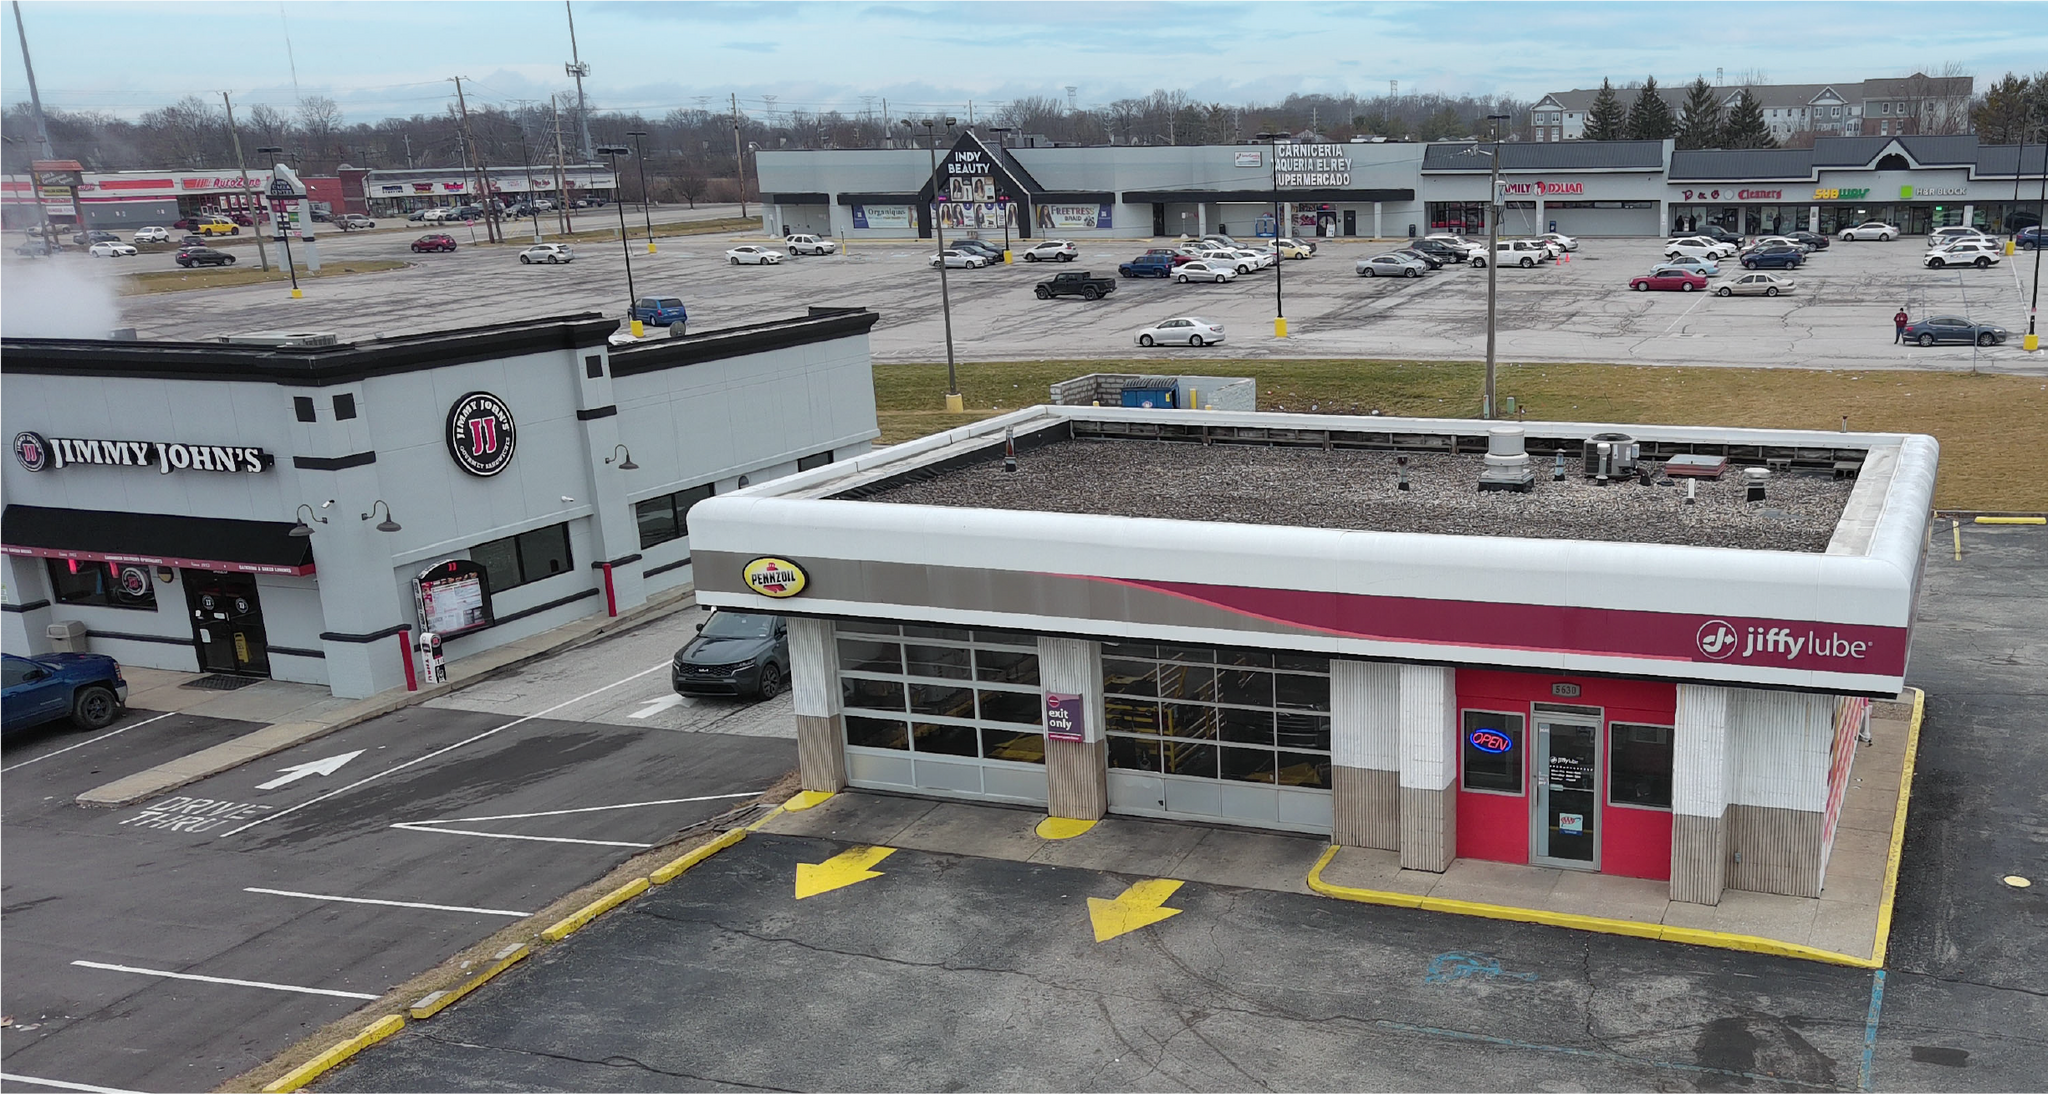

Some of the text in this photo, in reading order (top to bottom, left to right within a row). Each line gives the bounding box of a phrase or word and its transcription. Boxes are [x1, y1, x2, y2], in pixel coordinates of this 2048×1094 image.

[954, 151, 982, 162] INDY
[1278, 144, 1343, 157] CARNICERIA
[947, 163, 990, 174] BEAUTY
[213, 177, 261, 188] AutoZne
[1547, 182, 1584, 194] DOLLAR
[1738, 188, 1783, 200] Cleaners
[1813, 188, 1871, 200] SUBWAY
[1916, 187, 1967, 196] H&R BLOCK
[456, 399, 510, 440] JIMMY JOHN'S
[468, 415, 497, 456] JJ
[50, 438, 149, 469] JIMMY
[155, 442, 262, 474] JOHN'S
[751, 569, 796, 586] PENNZOIL
[1742, 626, 1806, 660] jiffy
[1048, 708, 1069, 719] exit
[1049, 718, 1072, 731] only
[1472, 731, 1510, 751] OPEN
[146, 796, 274, 819] DRIVE
[118, 810, 230, 833] THRU
